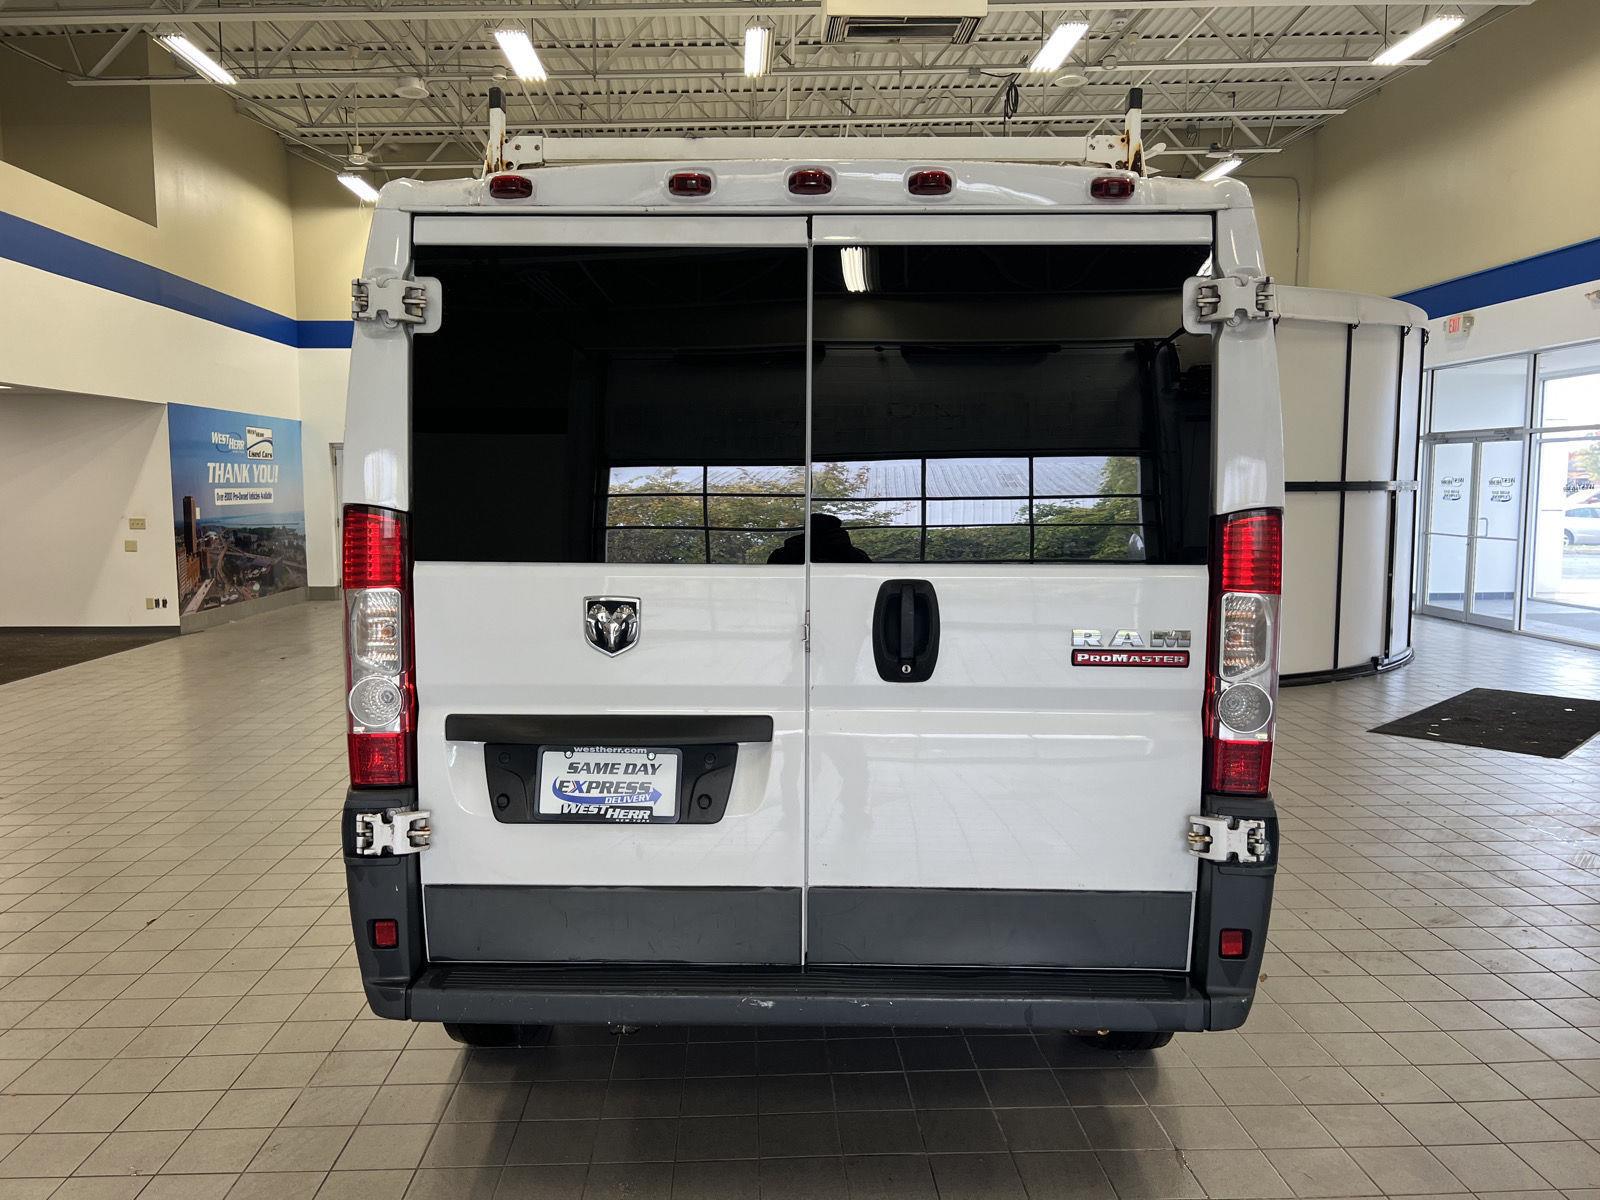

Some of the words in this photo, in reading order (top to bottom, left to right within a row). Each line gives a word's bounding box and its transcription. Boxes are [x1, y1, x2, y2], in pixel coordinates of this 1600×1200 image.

[1448, 317, 1460, 333] EXIT
[211, 431, 229, 444] WEST
[228, 438, 245, 450] HERR
[248, 450, 261, 458] Used
[261, 451, 272, 459] Cars
[207, 462, 250, 483] THANK
[253, 464, 279, 483] YOU!
[1071, 629, 1192, 648] RAM
[1076, 653, 1186, 663] PROMASTER
[573, 746, 648, 754] westherr.com
[567, 762, 621, 775] SAME
[623, 763, 662, 776] DAY
[558, 780, 652, 795] EXPRESS
[604, 794, 652, 804] DELIVERY
[561, 803, 609, 814] WEST
[605, 808, 651, 819] HERR
